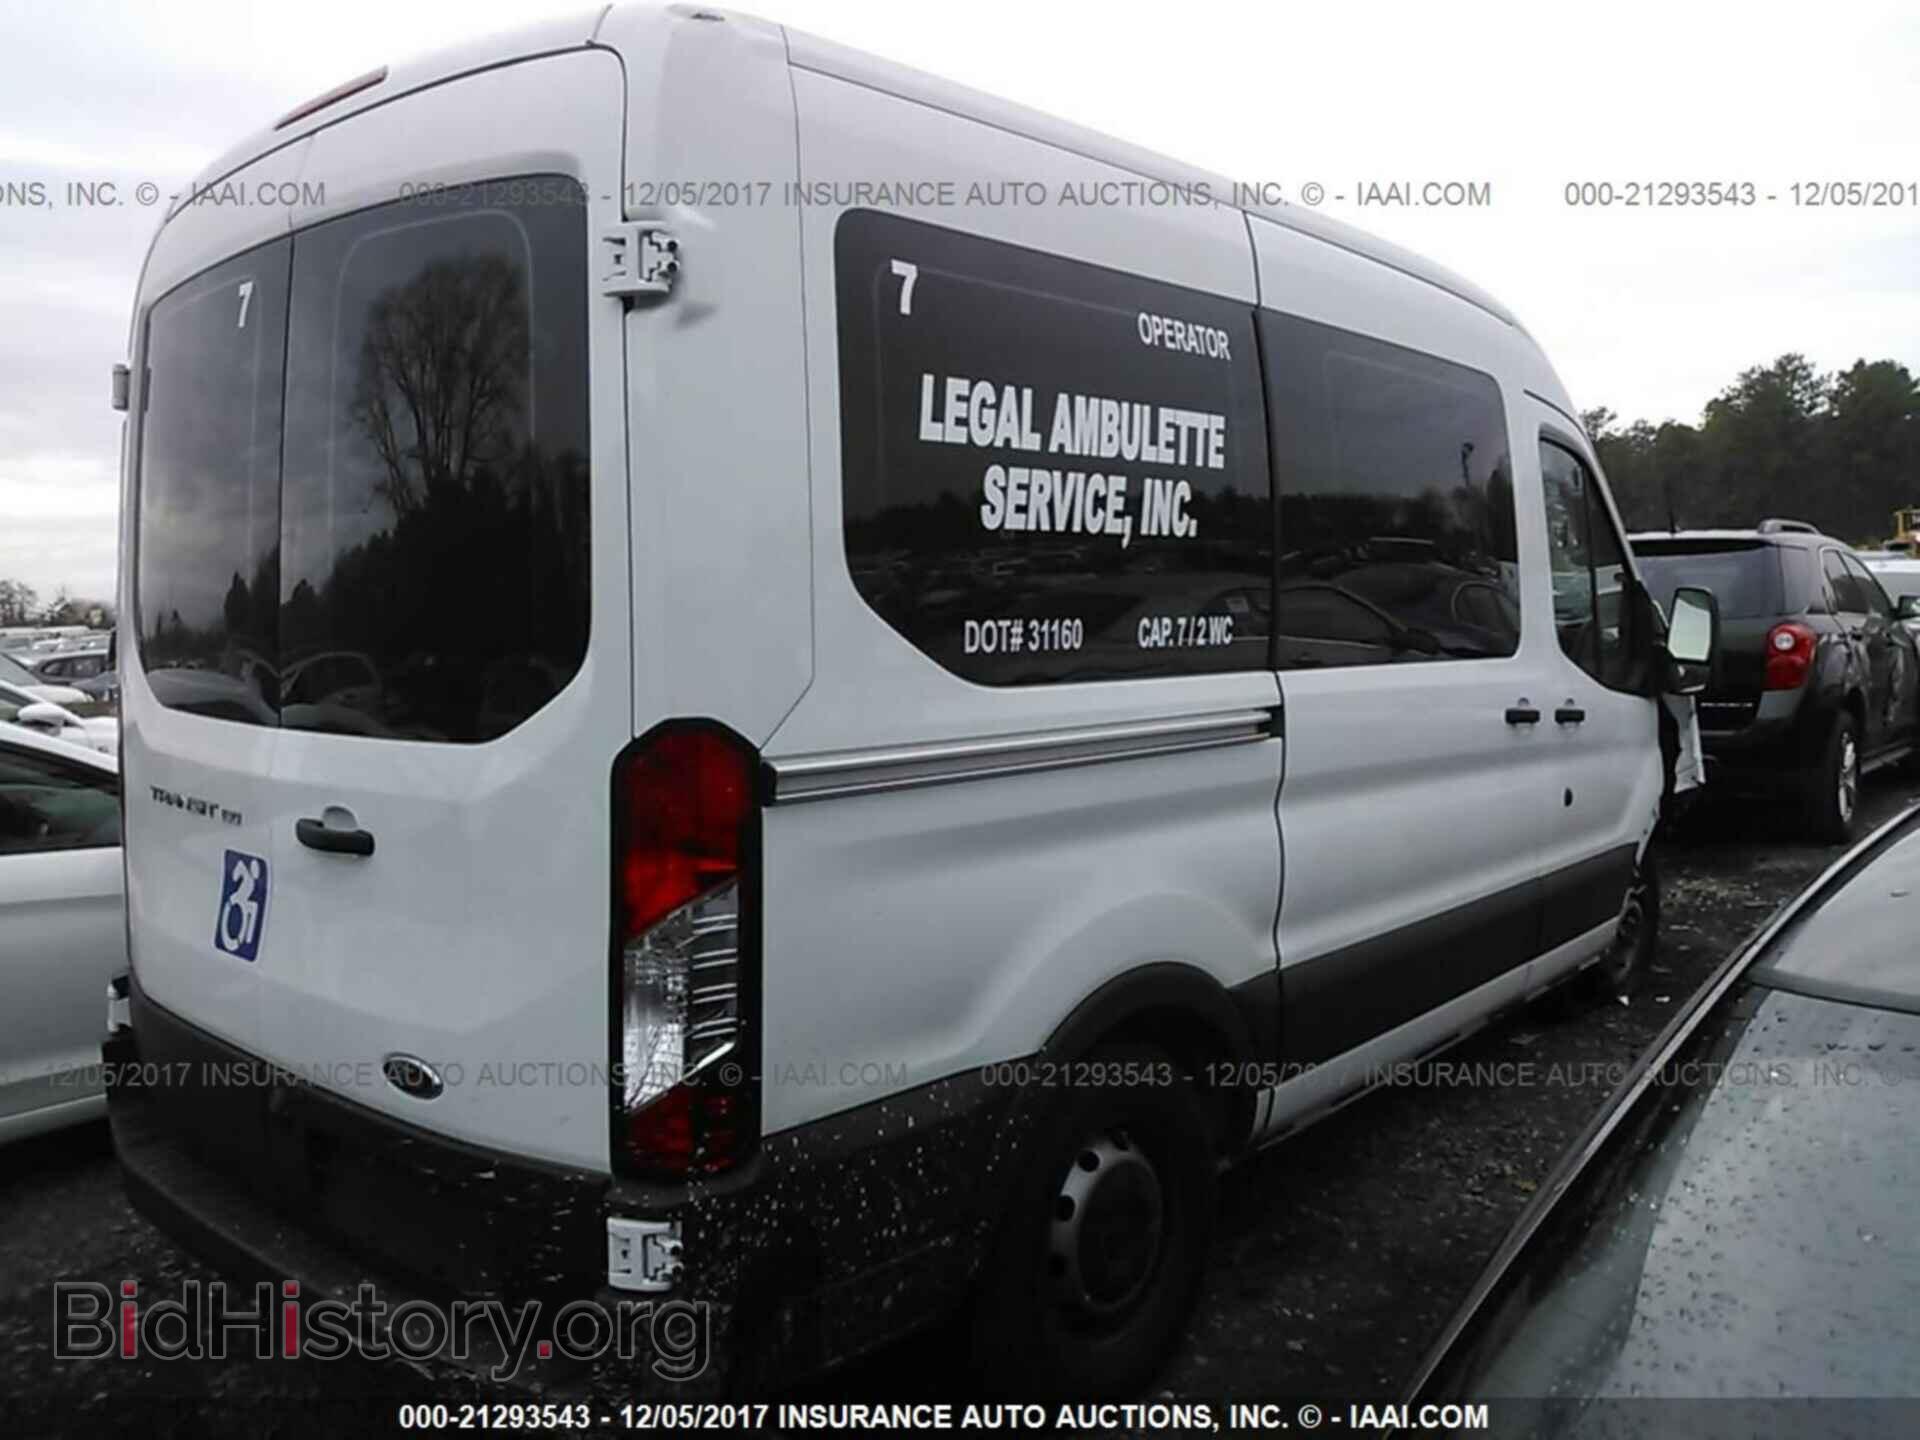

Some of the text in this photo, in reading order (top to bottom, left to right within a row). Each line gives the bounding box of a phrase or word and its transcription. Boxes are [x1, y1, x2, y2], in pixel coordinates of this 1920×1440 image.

[890, 259, 918, 315] 7
[1137, 312, 1232, 360] OPERATOR
[918, 373, 1226, 469] LEGAL AMBULETTE
[980, 464, 1198, 549] SERVICE, INC.
[964, 618, 1084, 653] DOT# 31160
[1137, 617, 1174, 649] CAP.
